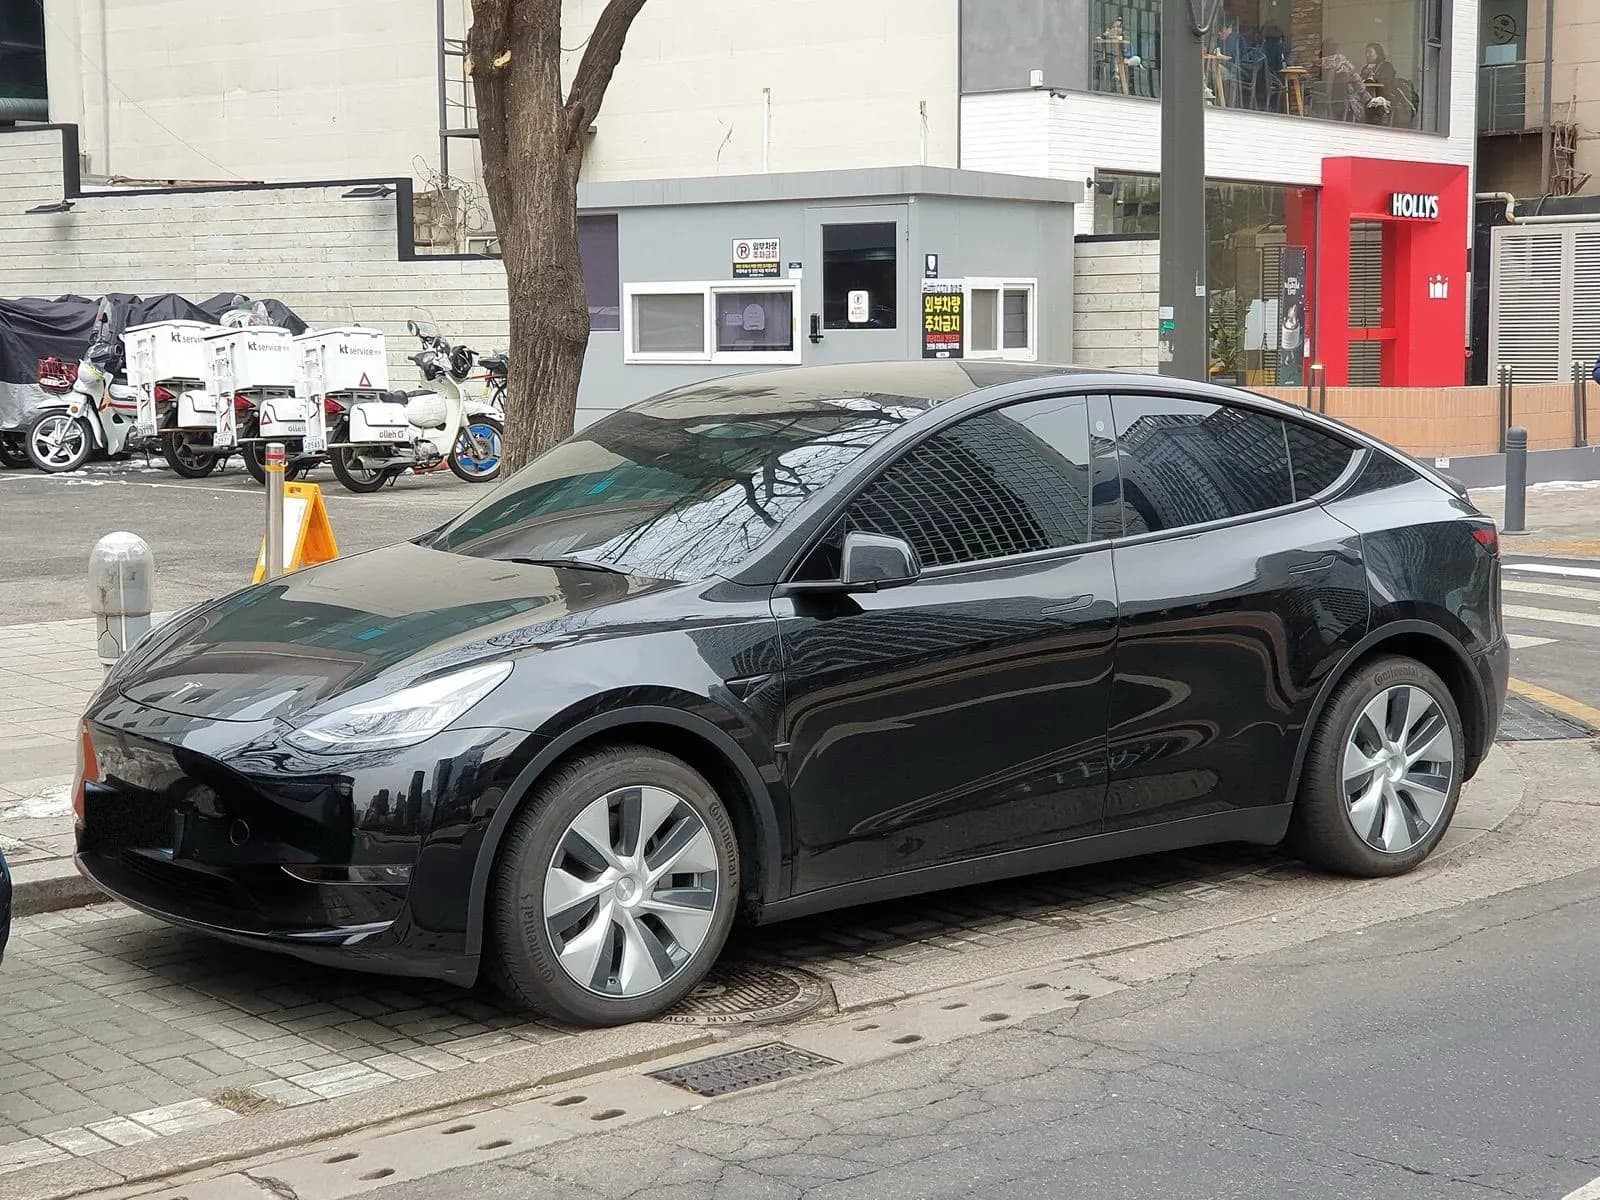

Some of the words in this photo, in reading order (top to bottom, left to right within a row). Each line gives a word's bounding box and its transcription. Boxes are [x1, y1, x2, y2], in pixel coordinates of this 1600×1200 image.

[1392, 192, 1439, 219] HOLLYS
[753, 242, 777, 250] 외부차량
[753, 251, 777, 259] 주차금지
[924, 296, 960, 313] 외부차량
[924, 315, 960, 332] 주차금지
[171, 332, 181, 343] kt
[248, 341, 257, 351] kt
[258, 343, 282, 352] service
[339, 344, 348, 354] kt
[350, 346, 374, 356] service
[379, 429, 397, 439] olleh
[709, 802, 738, 877] Continental
[520, 904, 554, 983] Continental
